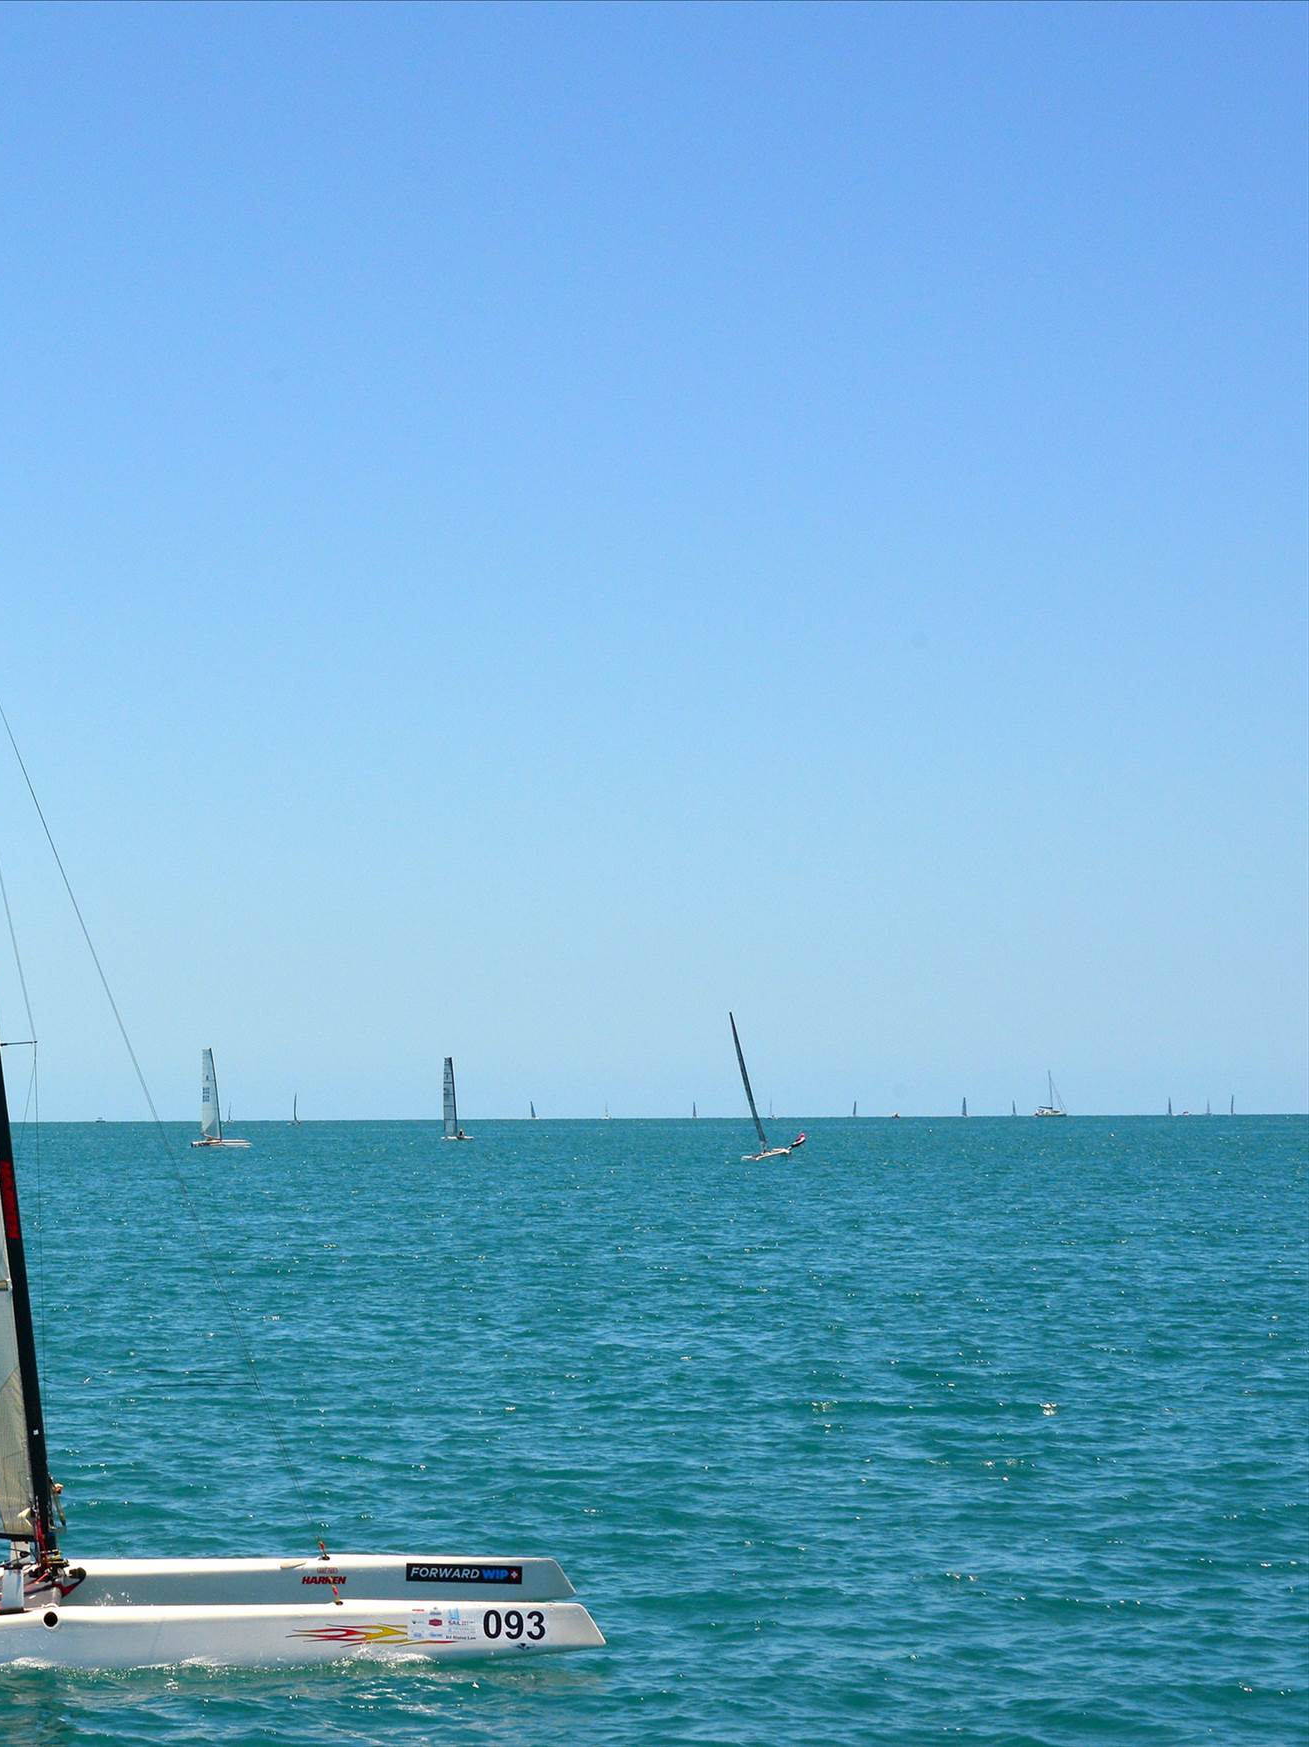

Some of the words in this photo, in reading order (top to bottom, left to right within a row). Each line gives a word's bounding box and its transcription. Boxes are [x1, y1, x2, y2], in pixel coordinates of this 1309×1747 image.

[410, 1567, 480, 1579] FORWARD
[482, 1569, 509, 1580] WIP
[483, 1609, 546, 1640] 093
